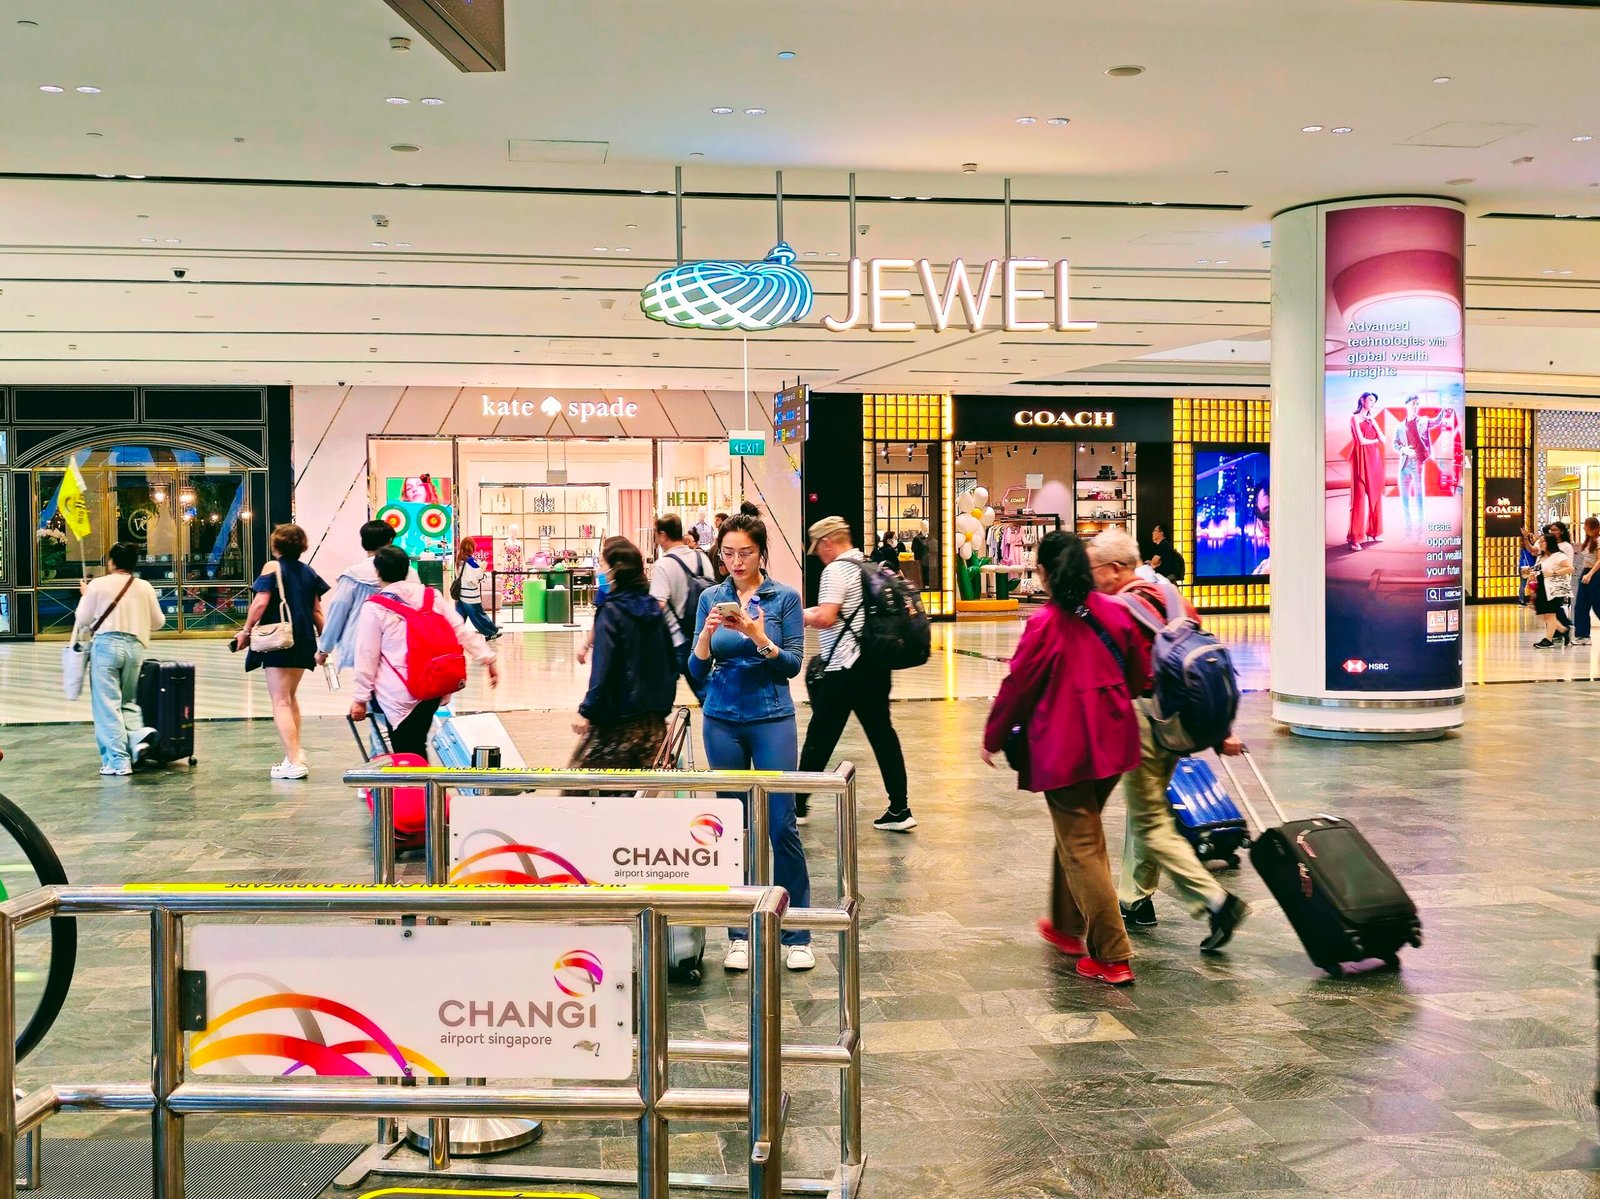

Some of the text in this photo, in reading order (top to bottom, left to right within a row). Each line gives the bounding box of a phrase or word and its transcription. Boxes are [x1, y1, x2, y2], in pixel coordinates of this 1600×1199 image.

[820, 257, 1098, 333] JEWEL
[1347, 320, 1410, 333] Advanced
[1347, 335, 1447, 349] technologies with
[1347, 350, 1429, 365] global wealth
[1347, 366, 1397, 378] insights
[481, 395, 639, 423] kate spade
[1014, 410, 1114, 428] COACH
[739, 442, 760, 454] EXIT
[667, 491, 708, 506] HELLO
[1485, 505, 1522, 514] COACH
[1427, 523, 1451, 532] create
[1426, 550, 1443, 561] and
[1426, 567, 1446, 578] your
[1368, 662, 1389, 670] HSBC
[612, 846, 719, 867] CHANGI
[614, 868, 690, 880] airport singapore
[438, 999, 597, 1028] CHANGI
[440, 1032, 552, 1047] airport singapore
